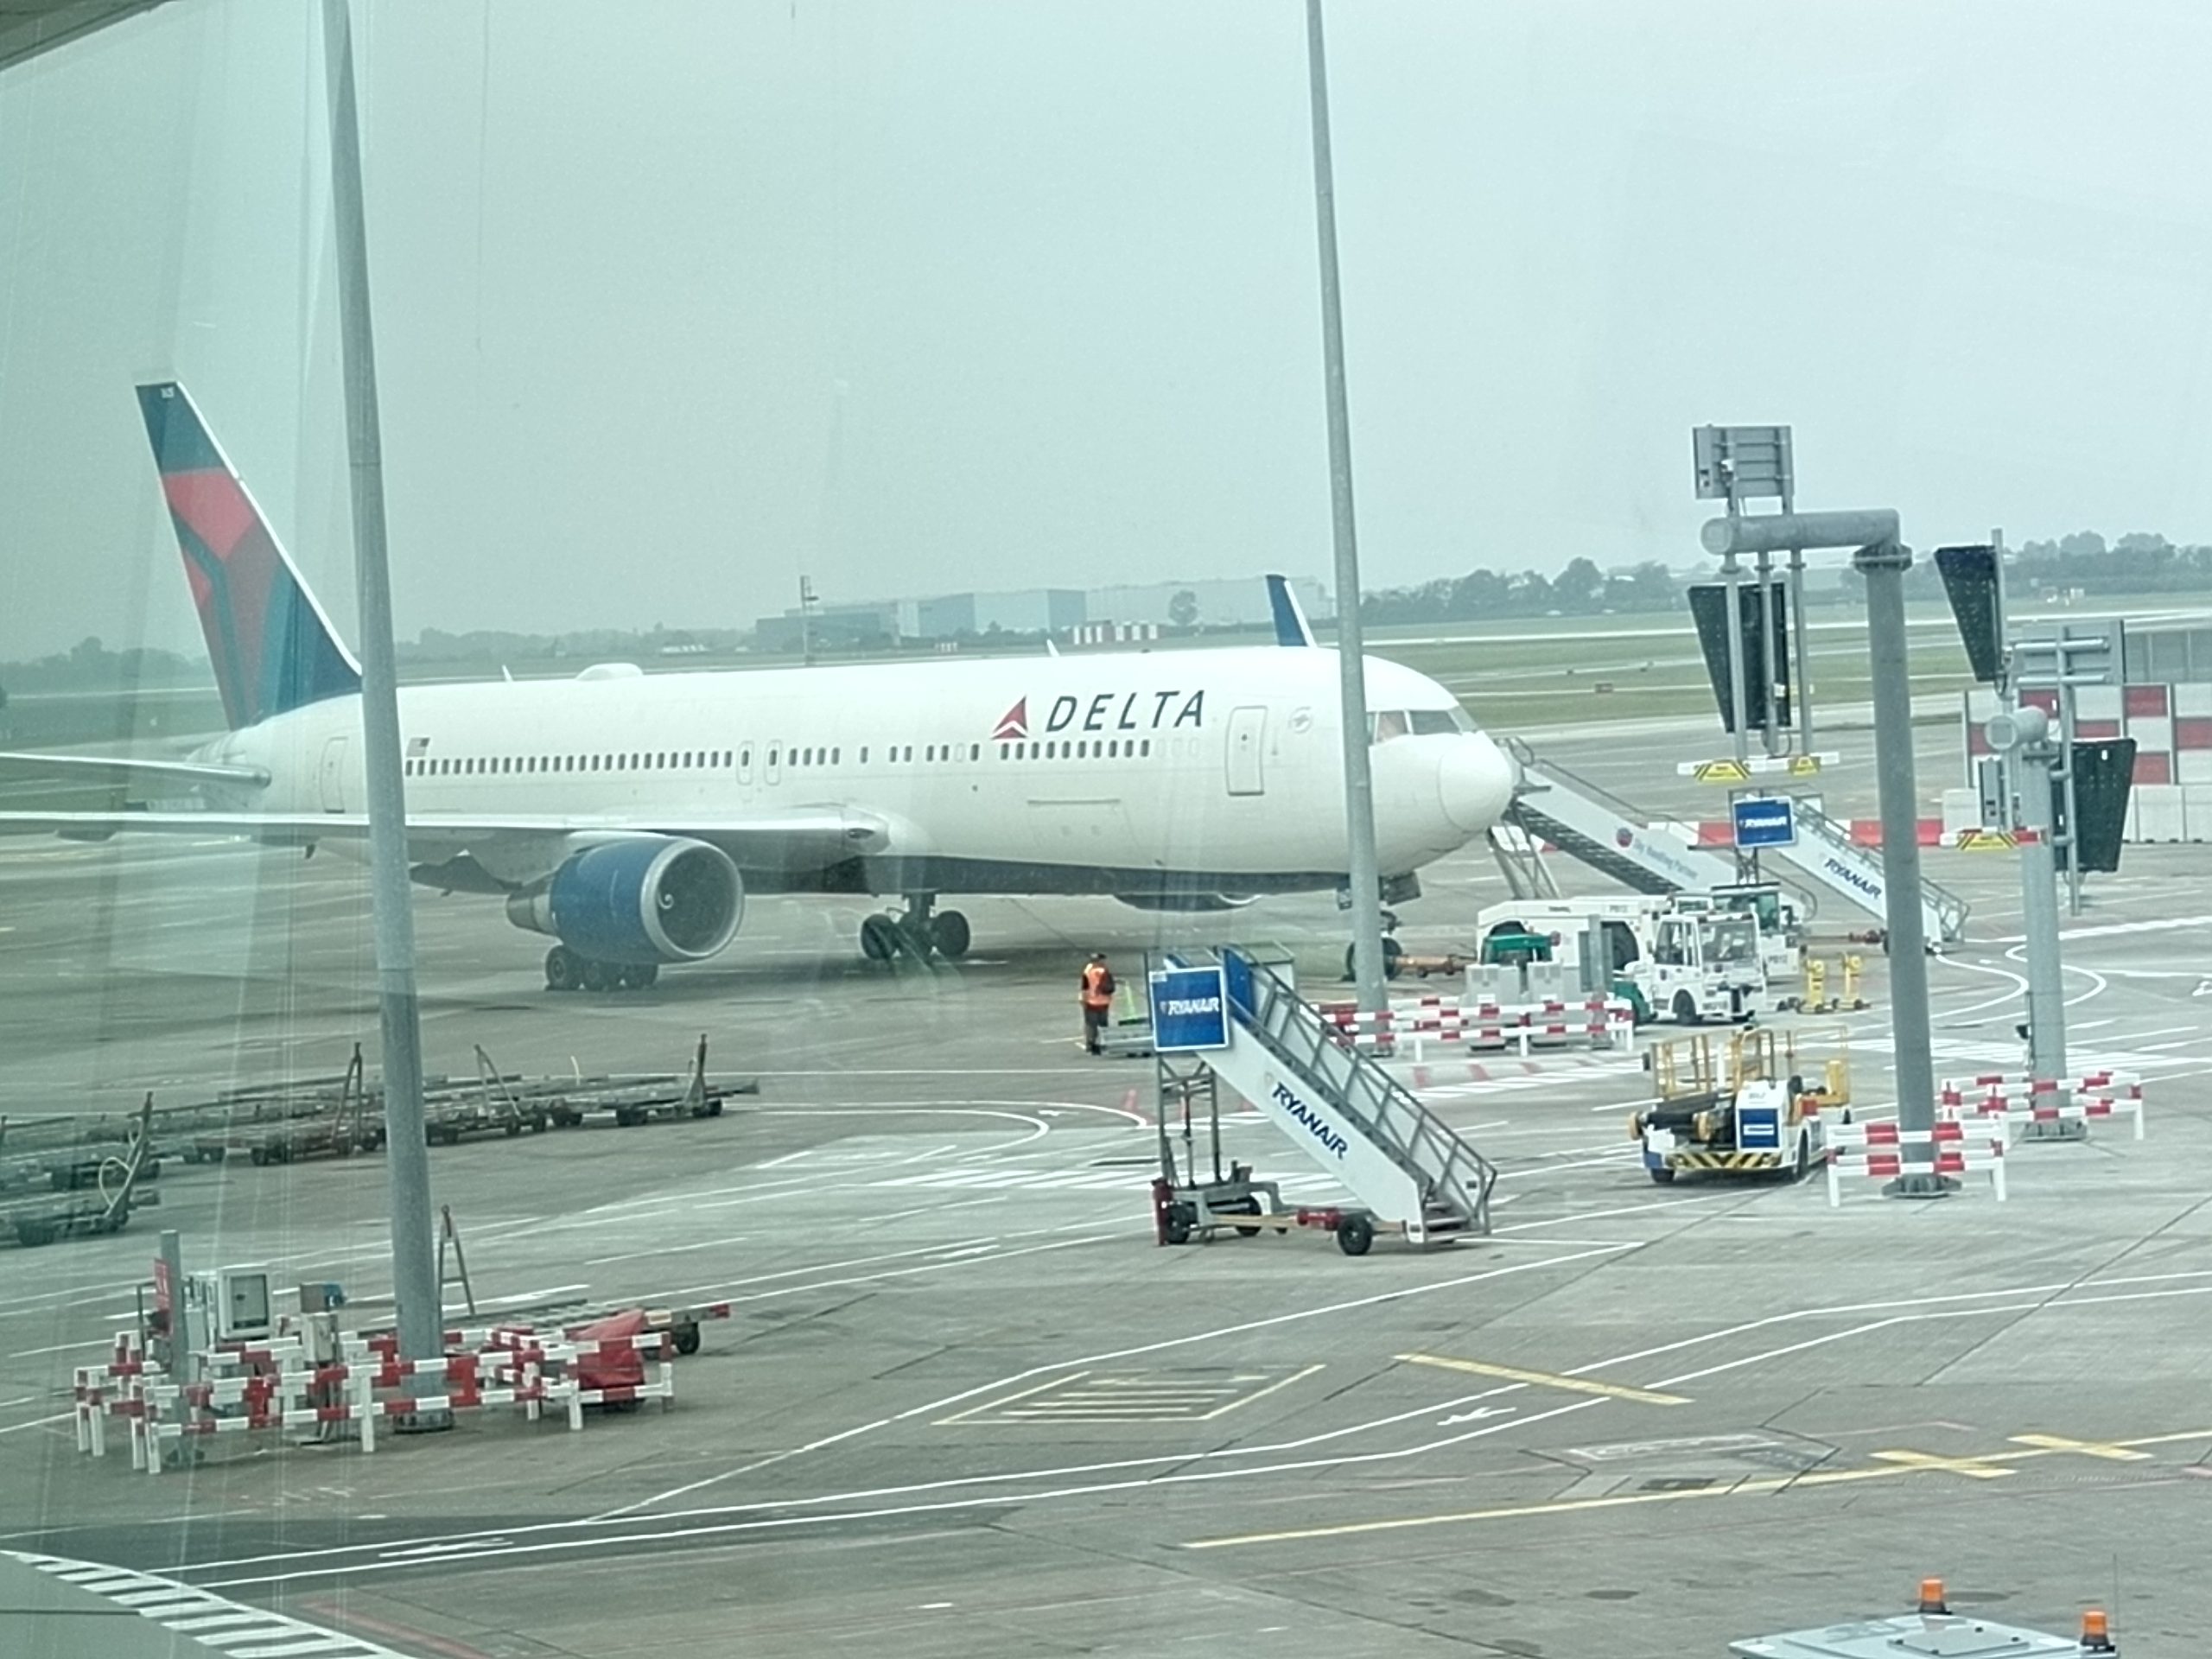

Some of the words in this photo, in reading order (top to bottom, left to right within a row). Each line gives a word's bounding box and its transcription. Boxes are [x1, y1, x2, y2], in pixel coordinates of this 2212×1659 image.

[1045, 690, 1205, 733] DELTA
[1824, 857, 1882, 899] RYANAIR
[1168, 996, 1219, 1016] RYANAIR
[1272, 1081, 1348, 1160] RYANAIR
